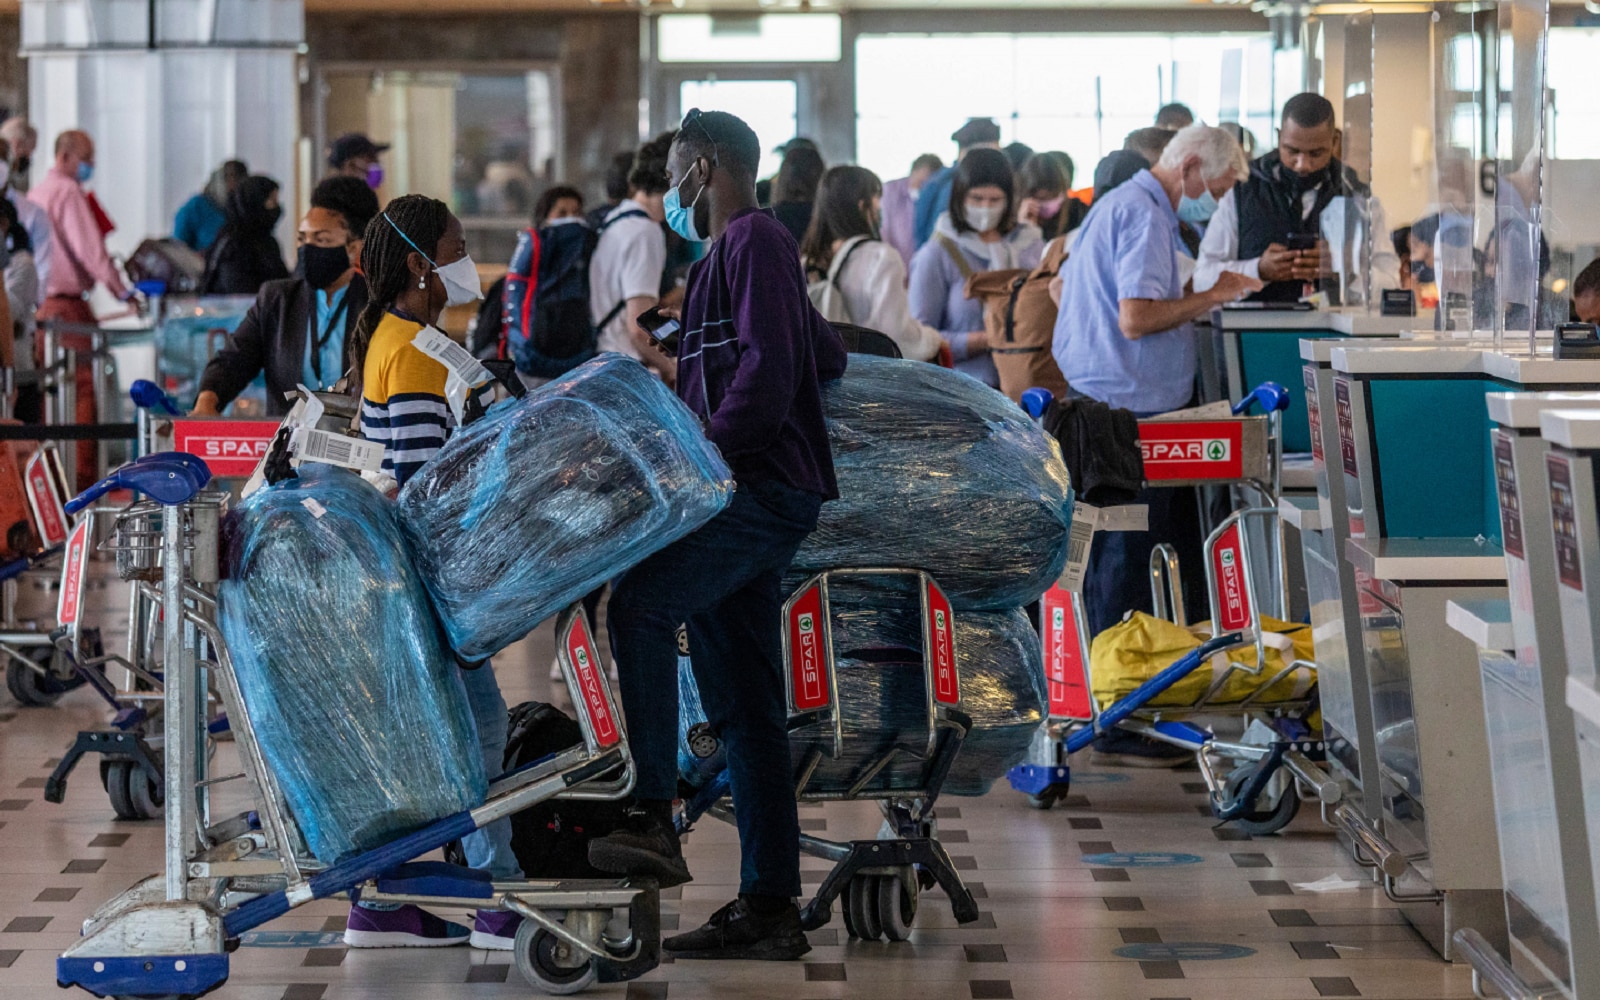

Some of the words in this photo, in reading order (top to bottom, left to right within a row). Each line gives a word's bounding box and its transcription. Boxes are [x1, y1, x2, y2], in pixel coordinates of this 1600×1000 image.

[1223, 565, 1240, 610] SPAR
[801, 633, 816, 683] SPAR
[937, 630, 949, 680] SPAR
[581, 669, 606, 719] SPAR
